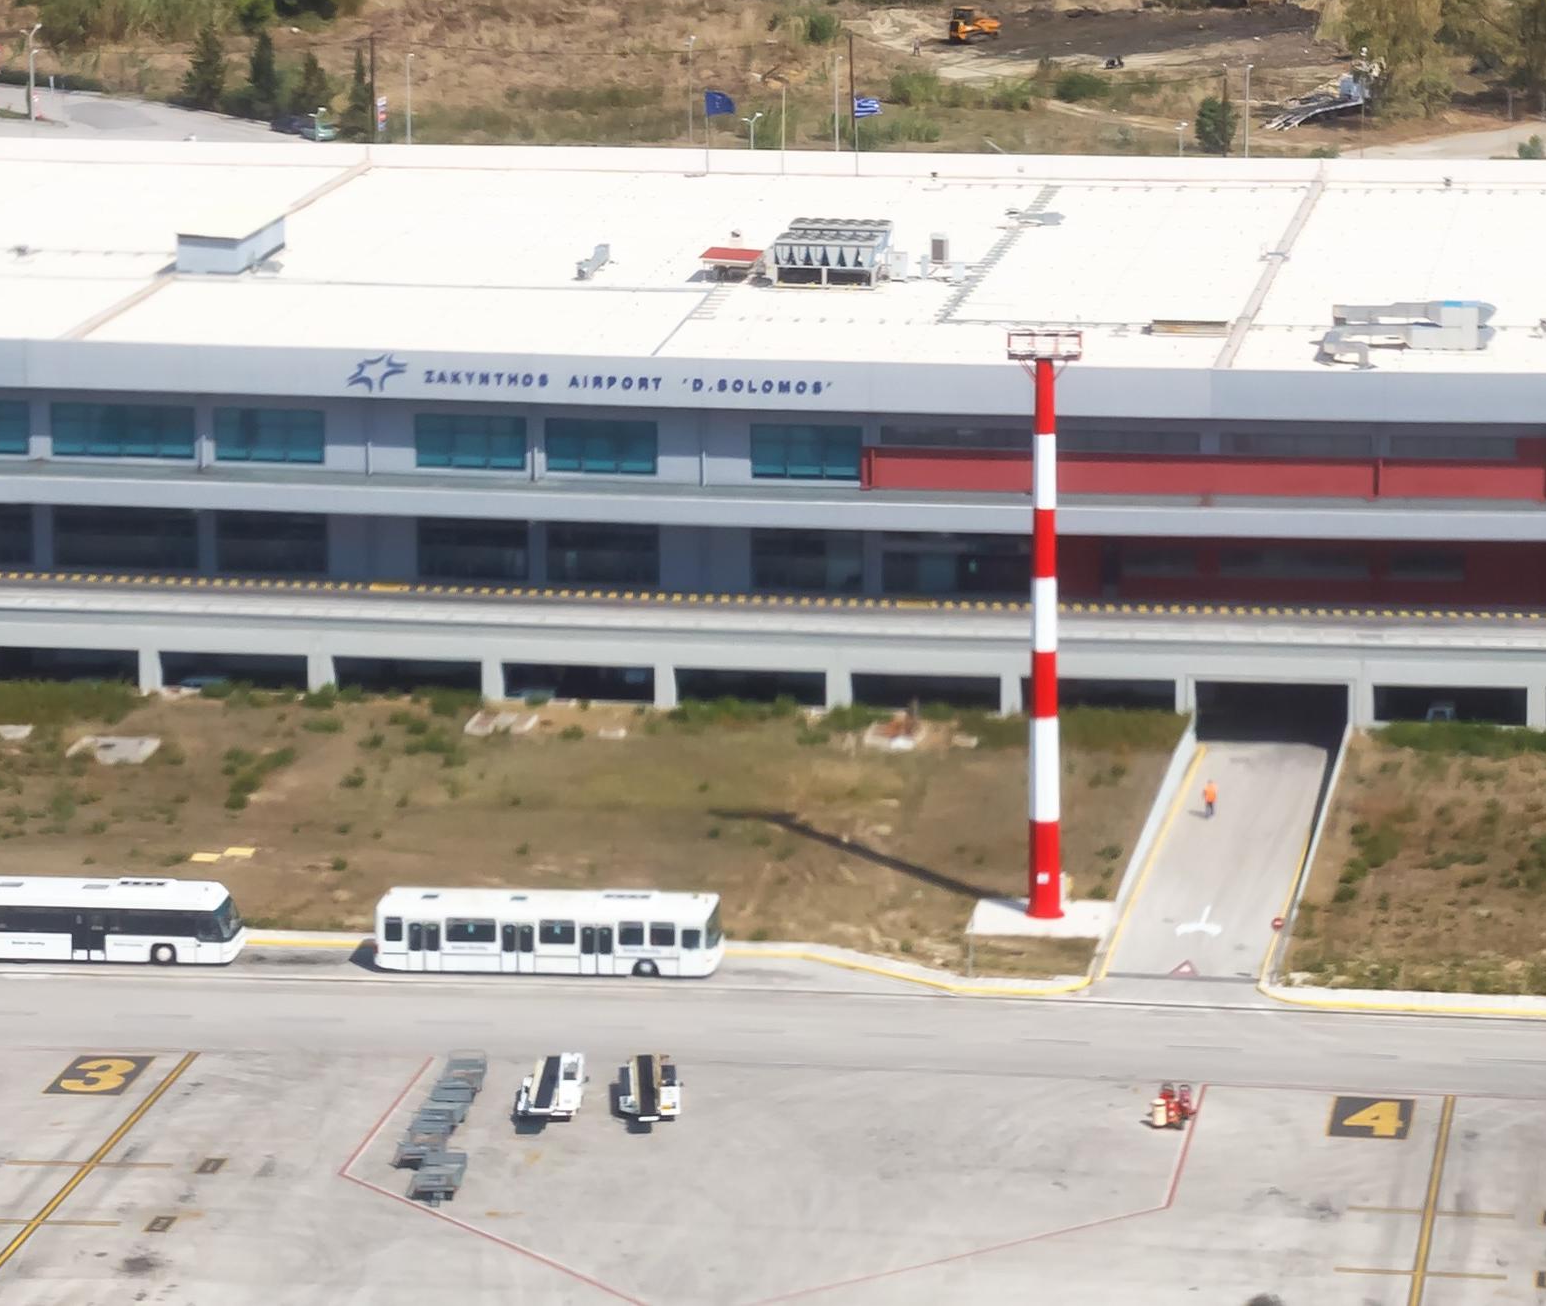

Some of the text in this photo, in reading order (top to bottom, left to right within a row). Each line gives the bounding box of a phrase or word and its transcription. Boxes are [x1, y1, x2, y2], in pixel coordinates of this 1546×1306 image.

[424, 370, 549, 387] ZAKYNTHOS
[568, 375, 662, 391] AIRPORT
[60, 1058, 137, 1092] 3
[1342, 1101, 1404, 1136] 4
